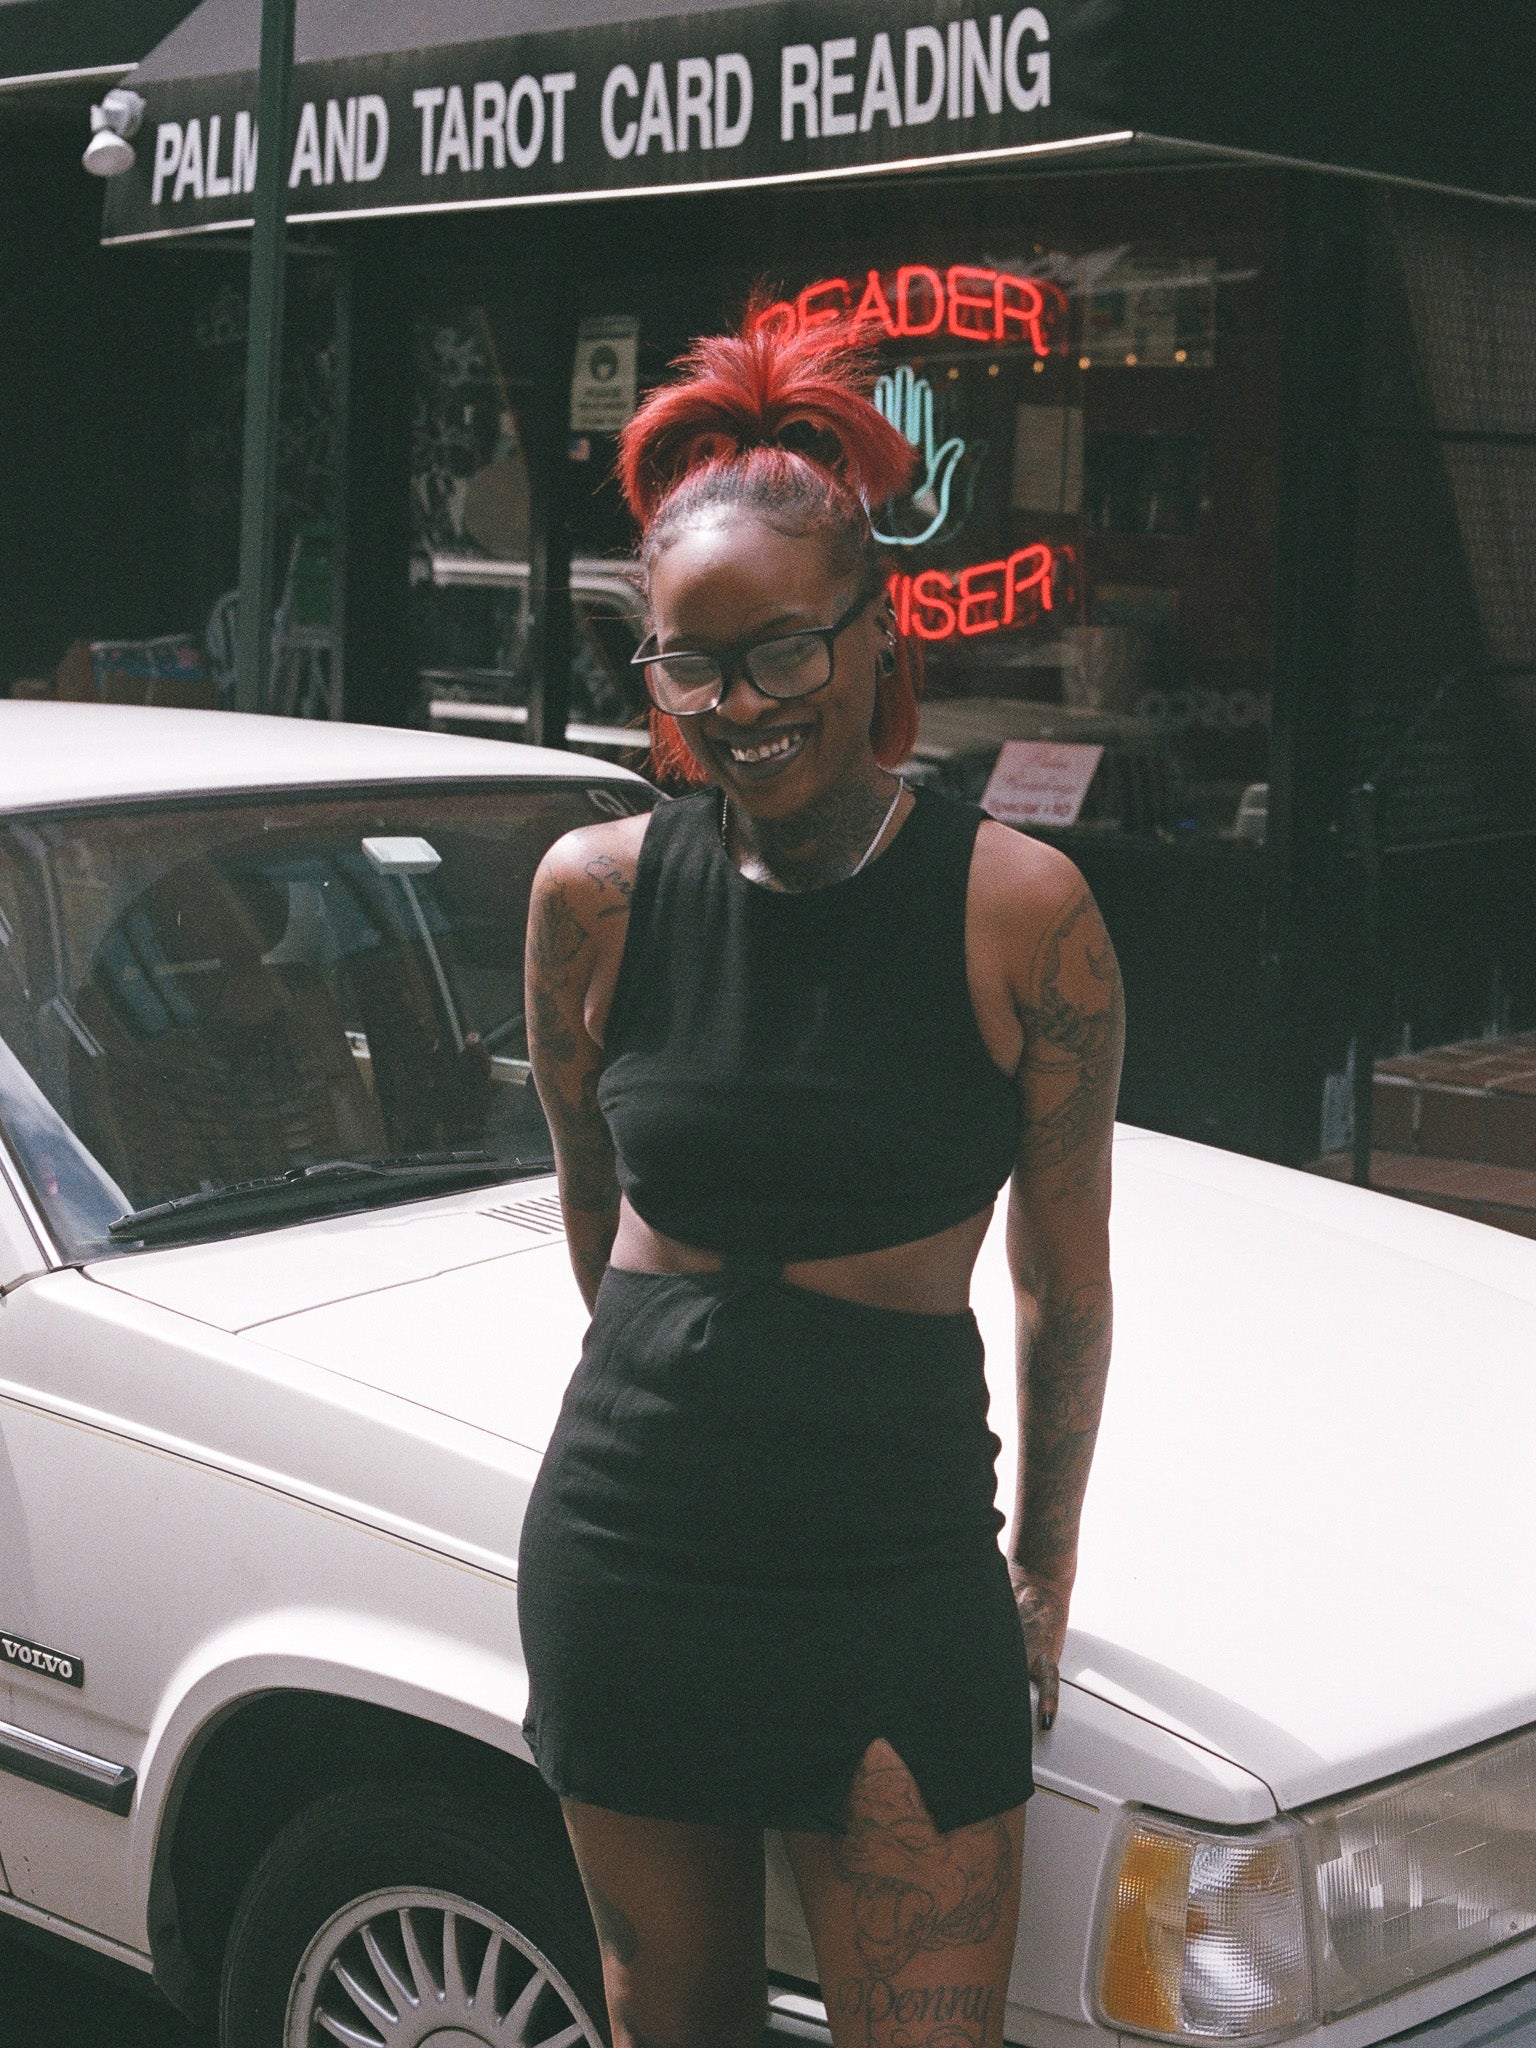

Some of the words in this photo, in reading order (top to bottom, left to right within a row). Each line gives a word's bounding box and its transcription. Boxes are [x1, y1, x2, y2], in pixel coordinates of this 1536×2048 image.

[151, 110, 260, 205] PALM
[288, 94, 390, 188] AND
[412, 70, 577, 176] TAROT
[600, 51, 754, 160] CARD
[780, 6, 1051, 141] READING
[1, 1638, 73, 1678] VOLVO
